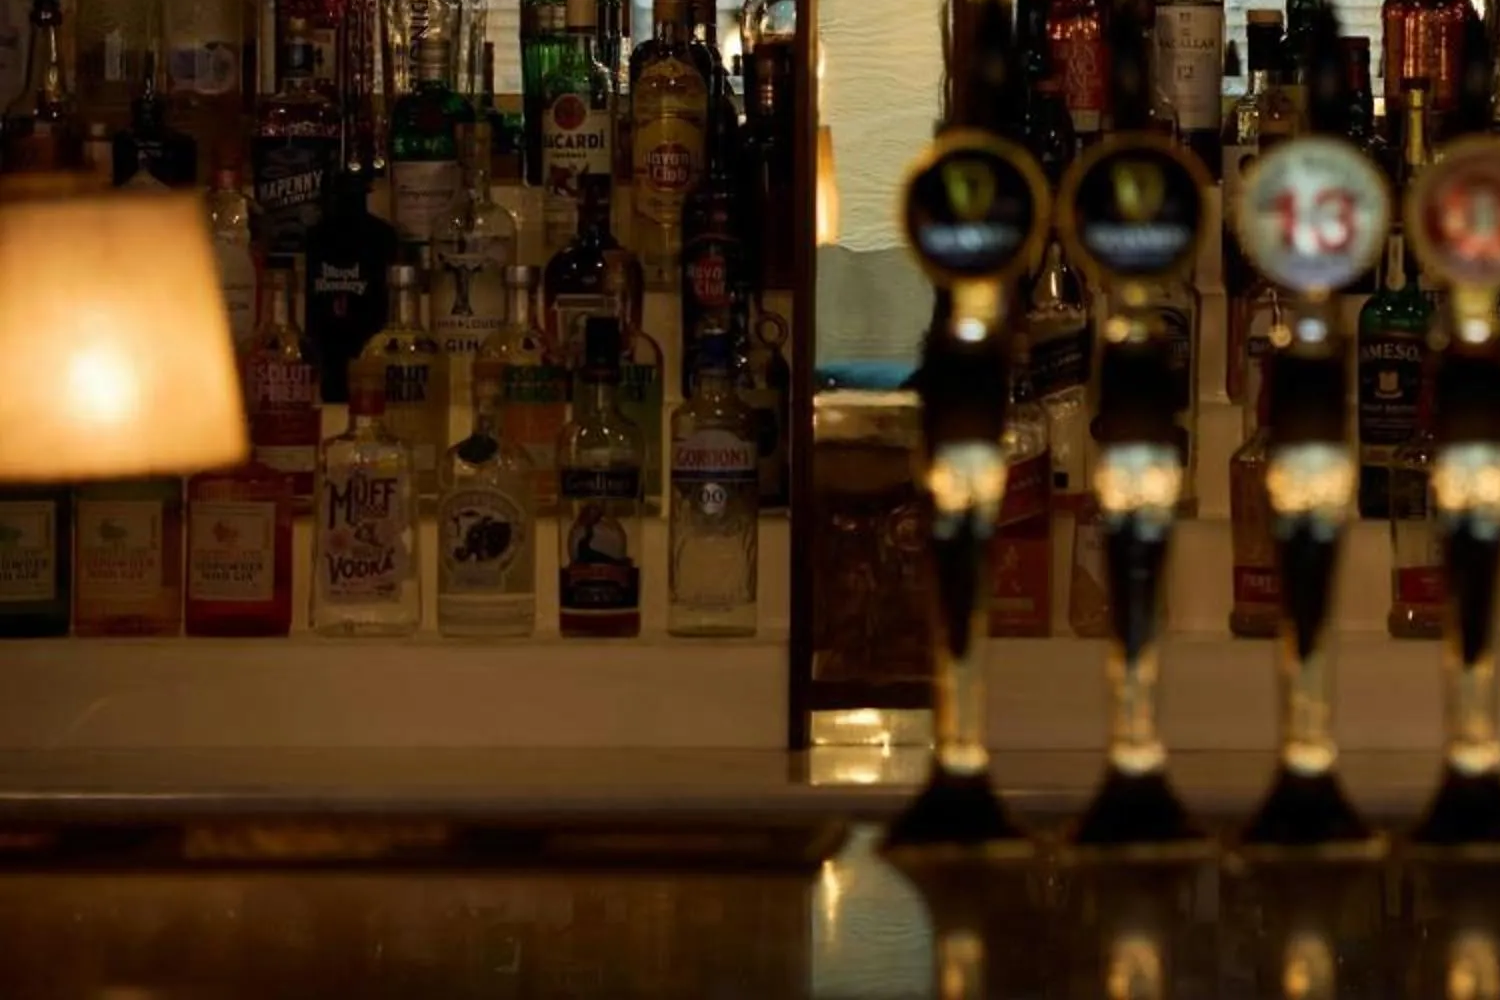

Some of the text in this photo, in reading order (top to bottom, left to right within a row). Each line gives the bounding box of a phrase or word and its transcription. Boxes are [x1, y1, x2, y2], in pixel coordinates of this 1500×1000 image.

[1360, 342, 1423, 363] AMESO
[324, 473, 398, 529] MUFF
[325, 547, 395, 585] VODKA
